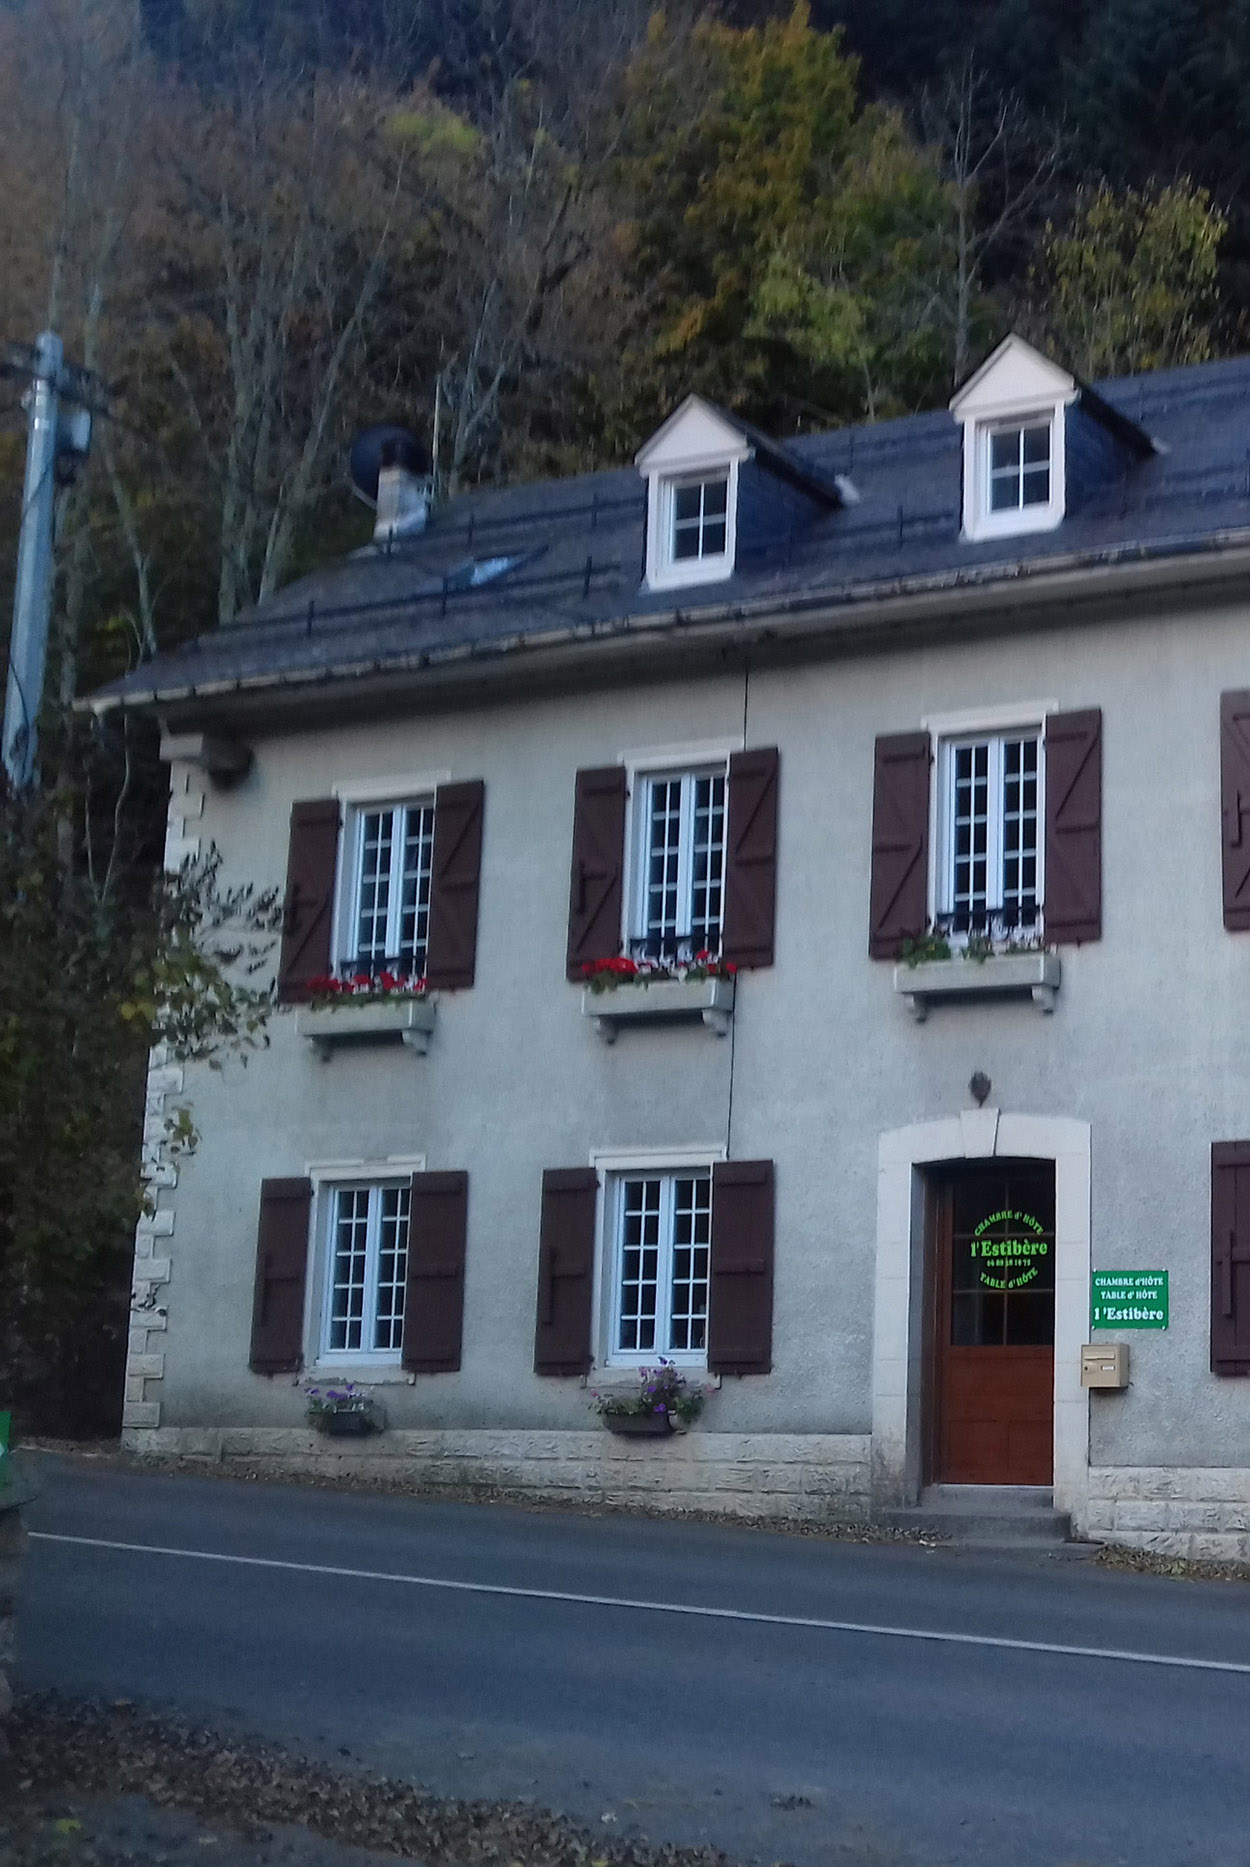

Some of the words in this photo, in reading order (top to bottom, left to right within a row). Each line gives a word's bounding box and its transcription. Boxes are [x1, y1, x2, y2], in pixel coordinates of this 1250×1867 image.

[974, 1210, 1013, 1236] CHAMBRE
[970, 1238, 1048, 1257] l'Estibère
[980, 1272, 1006, 1289] TABLE
[1094, 1277, 1134, 1286] CHAMBRE
[1100, 1290, 1126, 1300] TABLE
